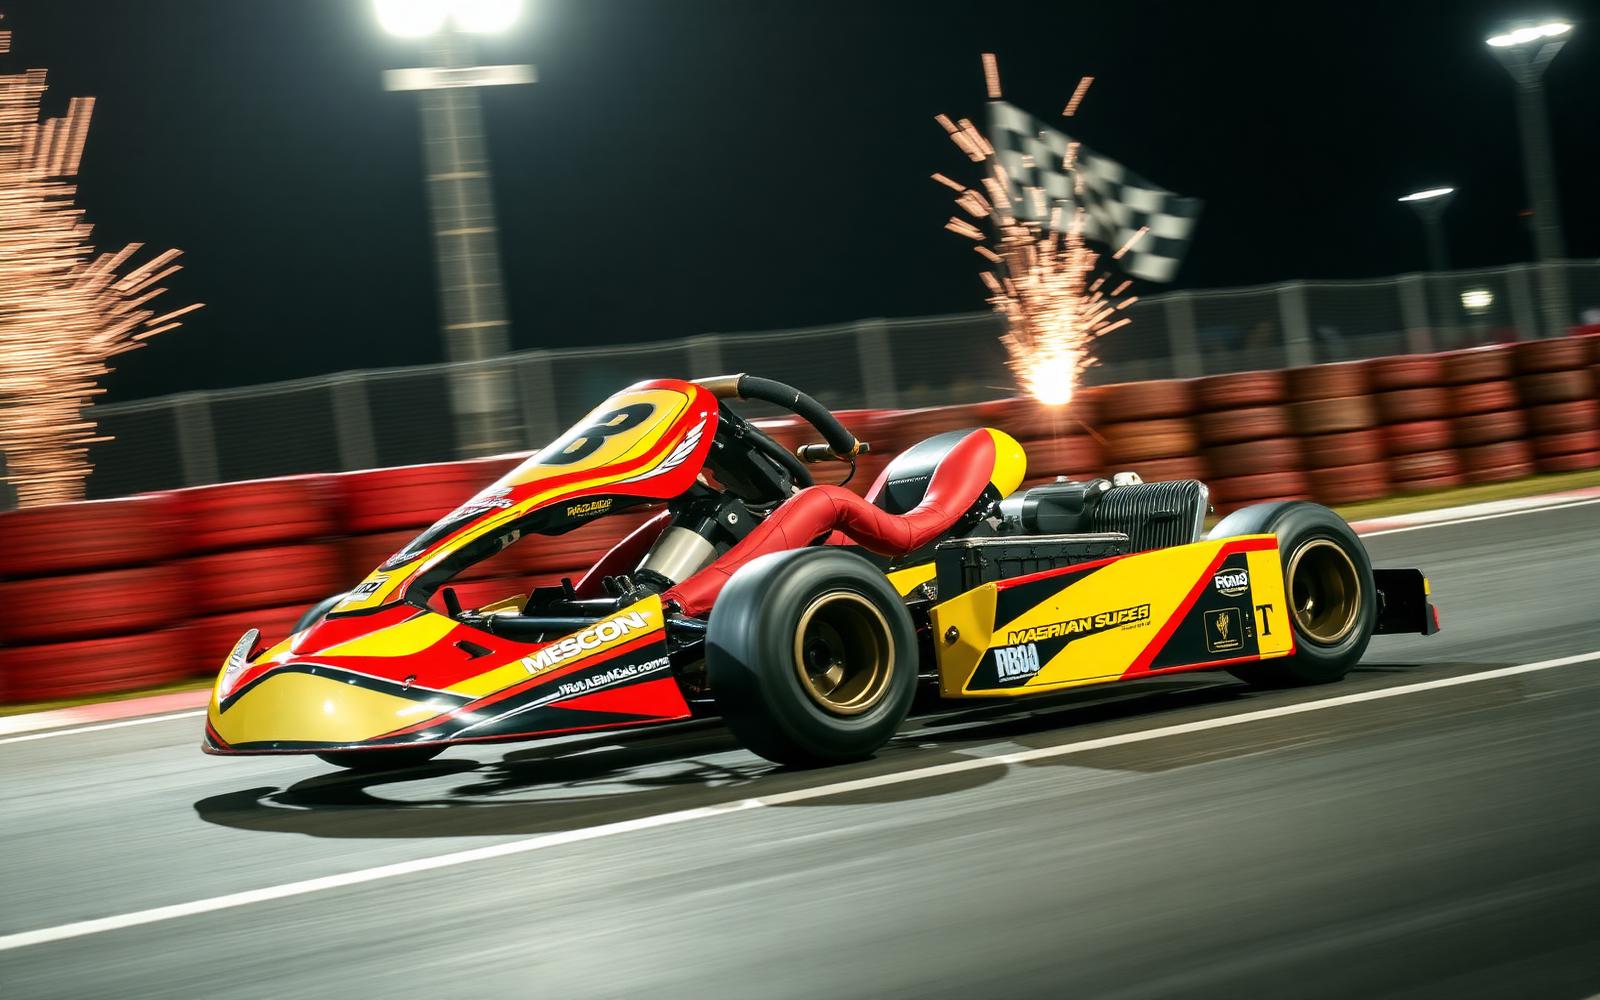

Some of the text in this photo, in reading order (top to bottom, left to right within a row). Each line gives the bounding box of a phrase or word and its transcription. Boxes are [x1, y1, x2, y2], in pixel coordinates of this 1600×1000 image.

[540, 402, 655, 465] 8
[521, 610, 648, 675] MESCON
[1255, 604, 1274, 636] T
